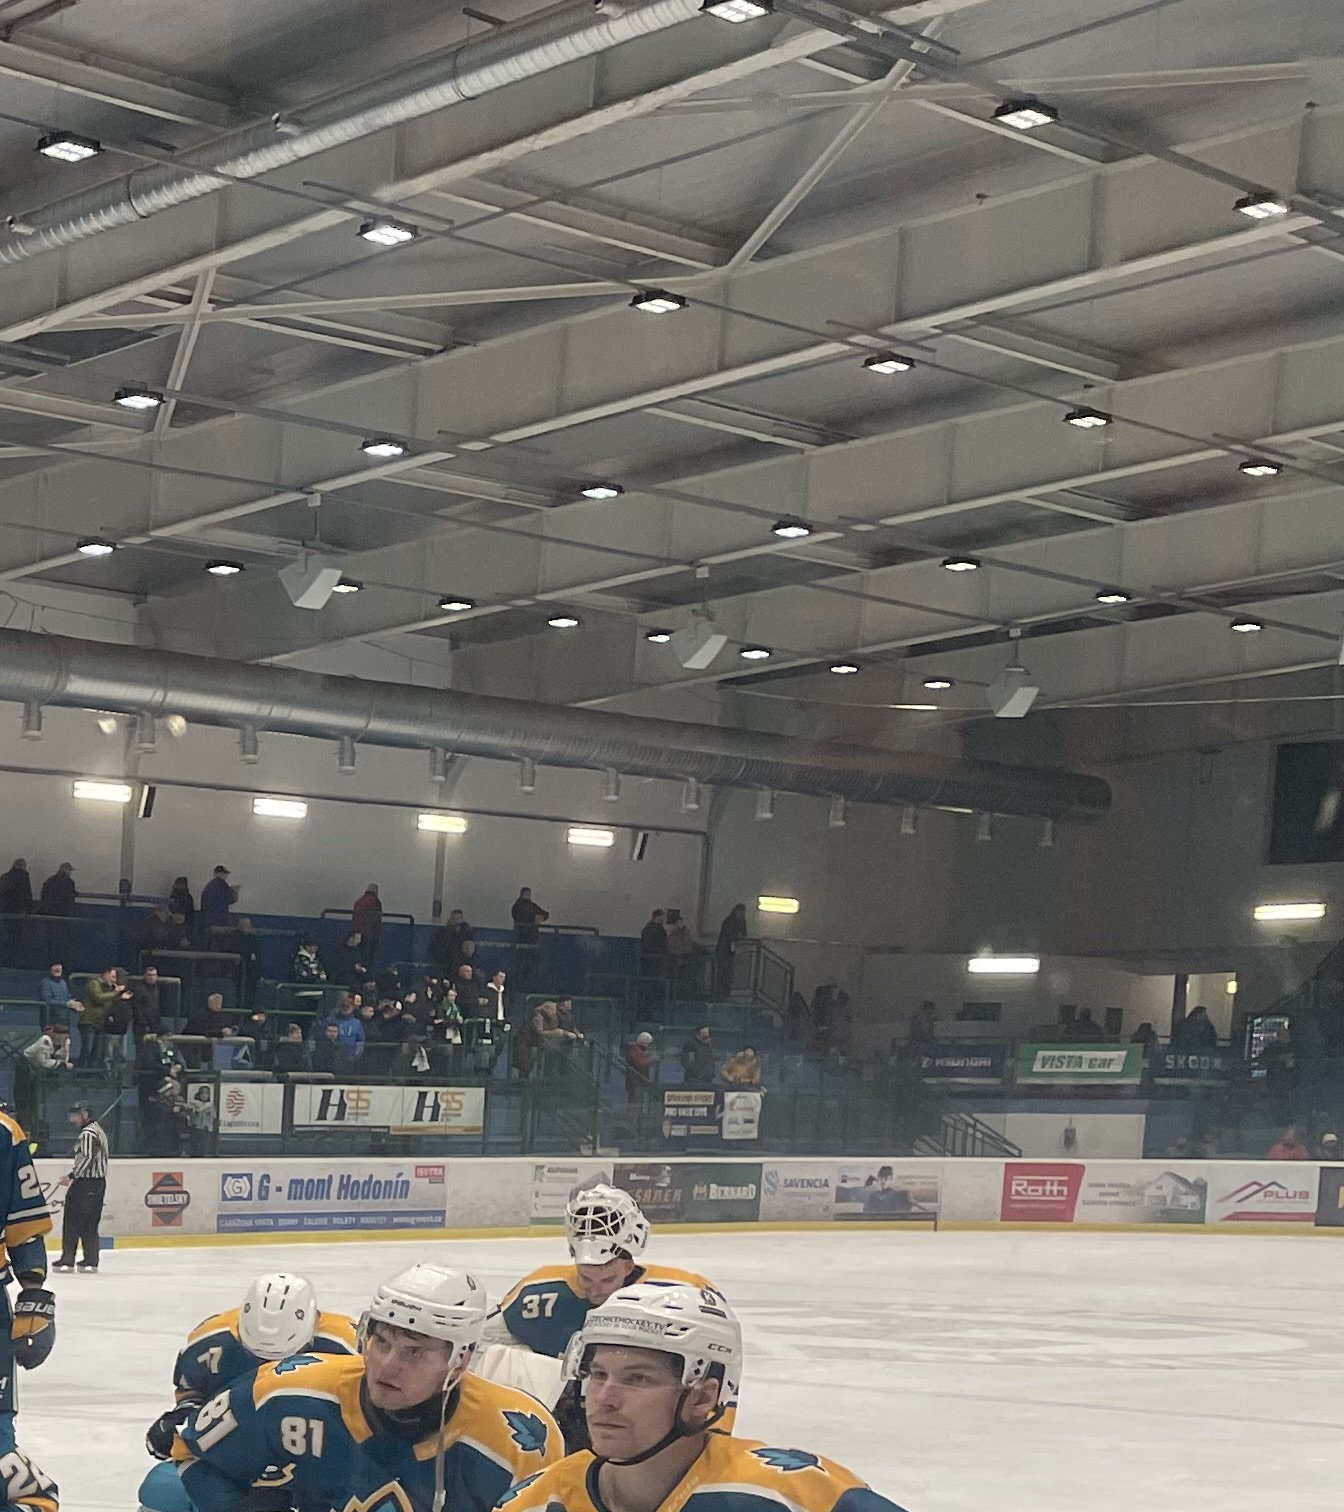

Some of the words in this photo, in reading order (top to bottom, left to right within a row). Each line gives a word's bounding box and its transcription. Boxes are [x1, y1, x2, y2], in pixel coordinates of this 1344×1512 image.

[1040, 1055, 1083, 1069] VISTA
[257, 1173, 271, 1200] G
[288, 1174, 333, 1201] mont
[337, 1172, 410, 1200] Hodonín
[783, 1178, 830, 1189] SAVENCIA
[1012, 1180, 1068, 1196] Roth
[521, 1293, 559, 1319] 37
[281, 1416, 325, 1459] 81
